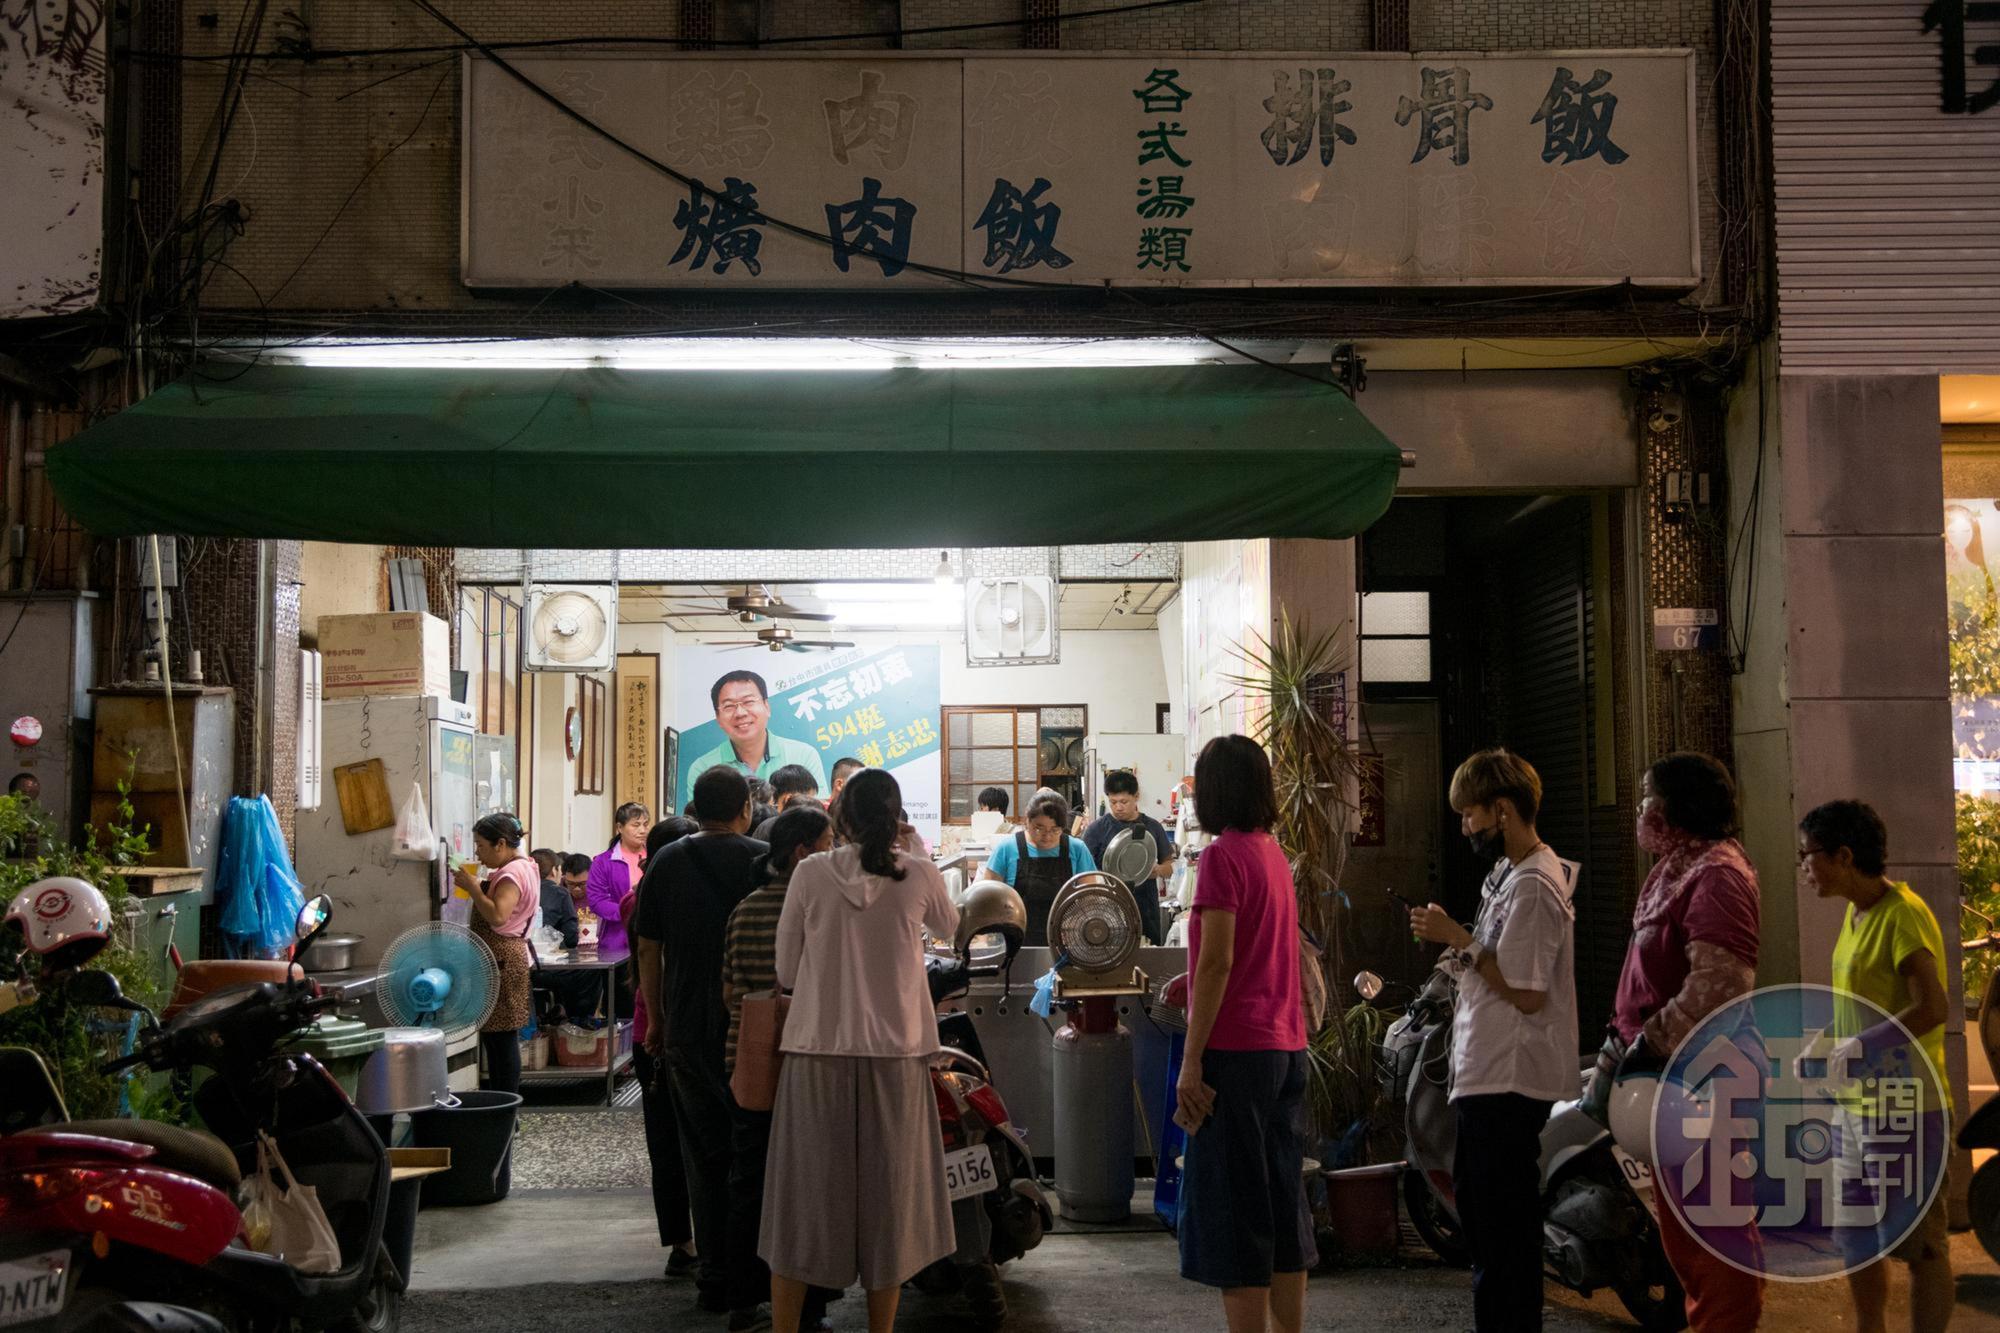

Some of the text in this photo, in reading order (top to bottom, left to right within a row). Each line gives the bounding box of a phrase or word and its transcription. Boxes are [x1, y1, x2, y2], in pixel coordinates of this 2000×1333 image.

[1259, 66, 1631, 167] 排骨飯
[1132, 67, 1196, 273] 各式湯類
[1672, 626, 1702, 649] 67
[326, 674, 364, 683] RR-50A
[787, 652, 913, 722] 不忘初衷
[815, 703, 887, 750] 594挺
[855, 717, 938, 769] 謝志忠
